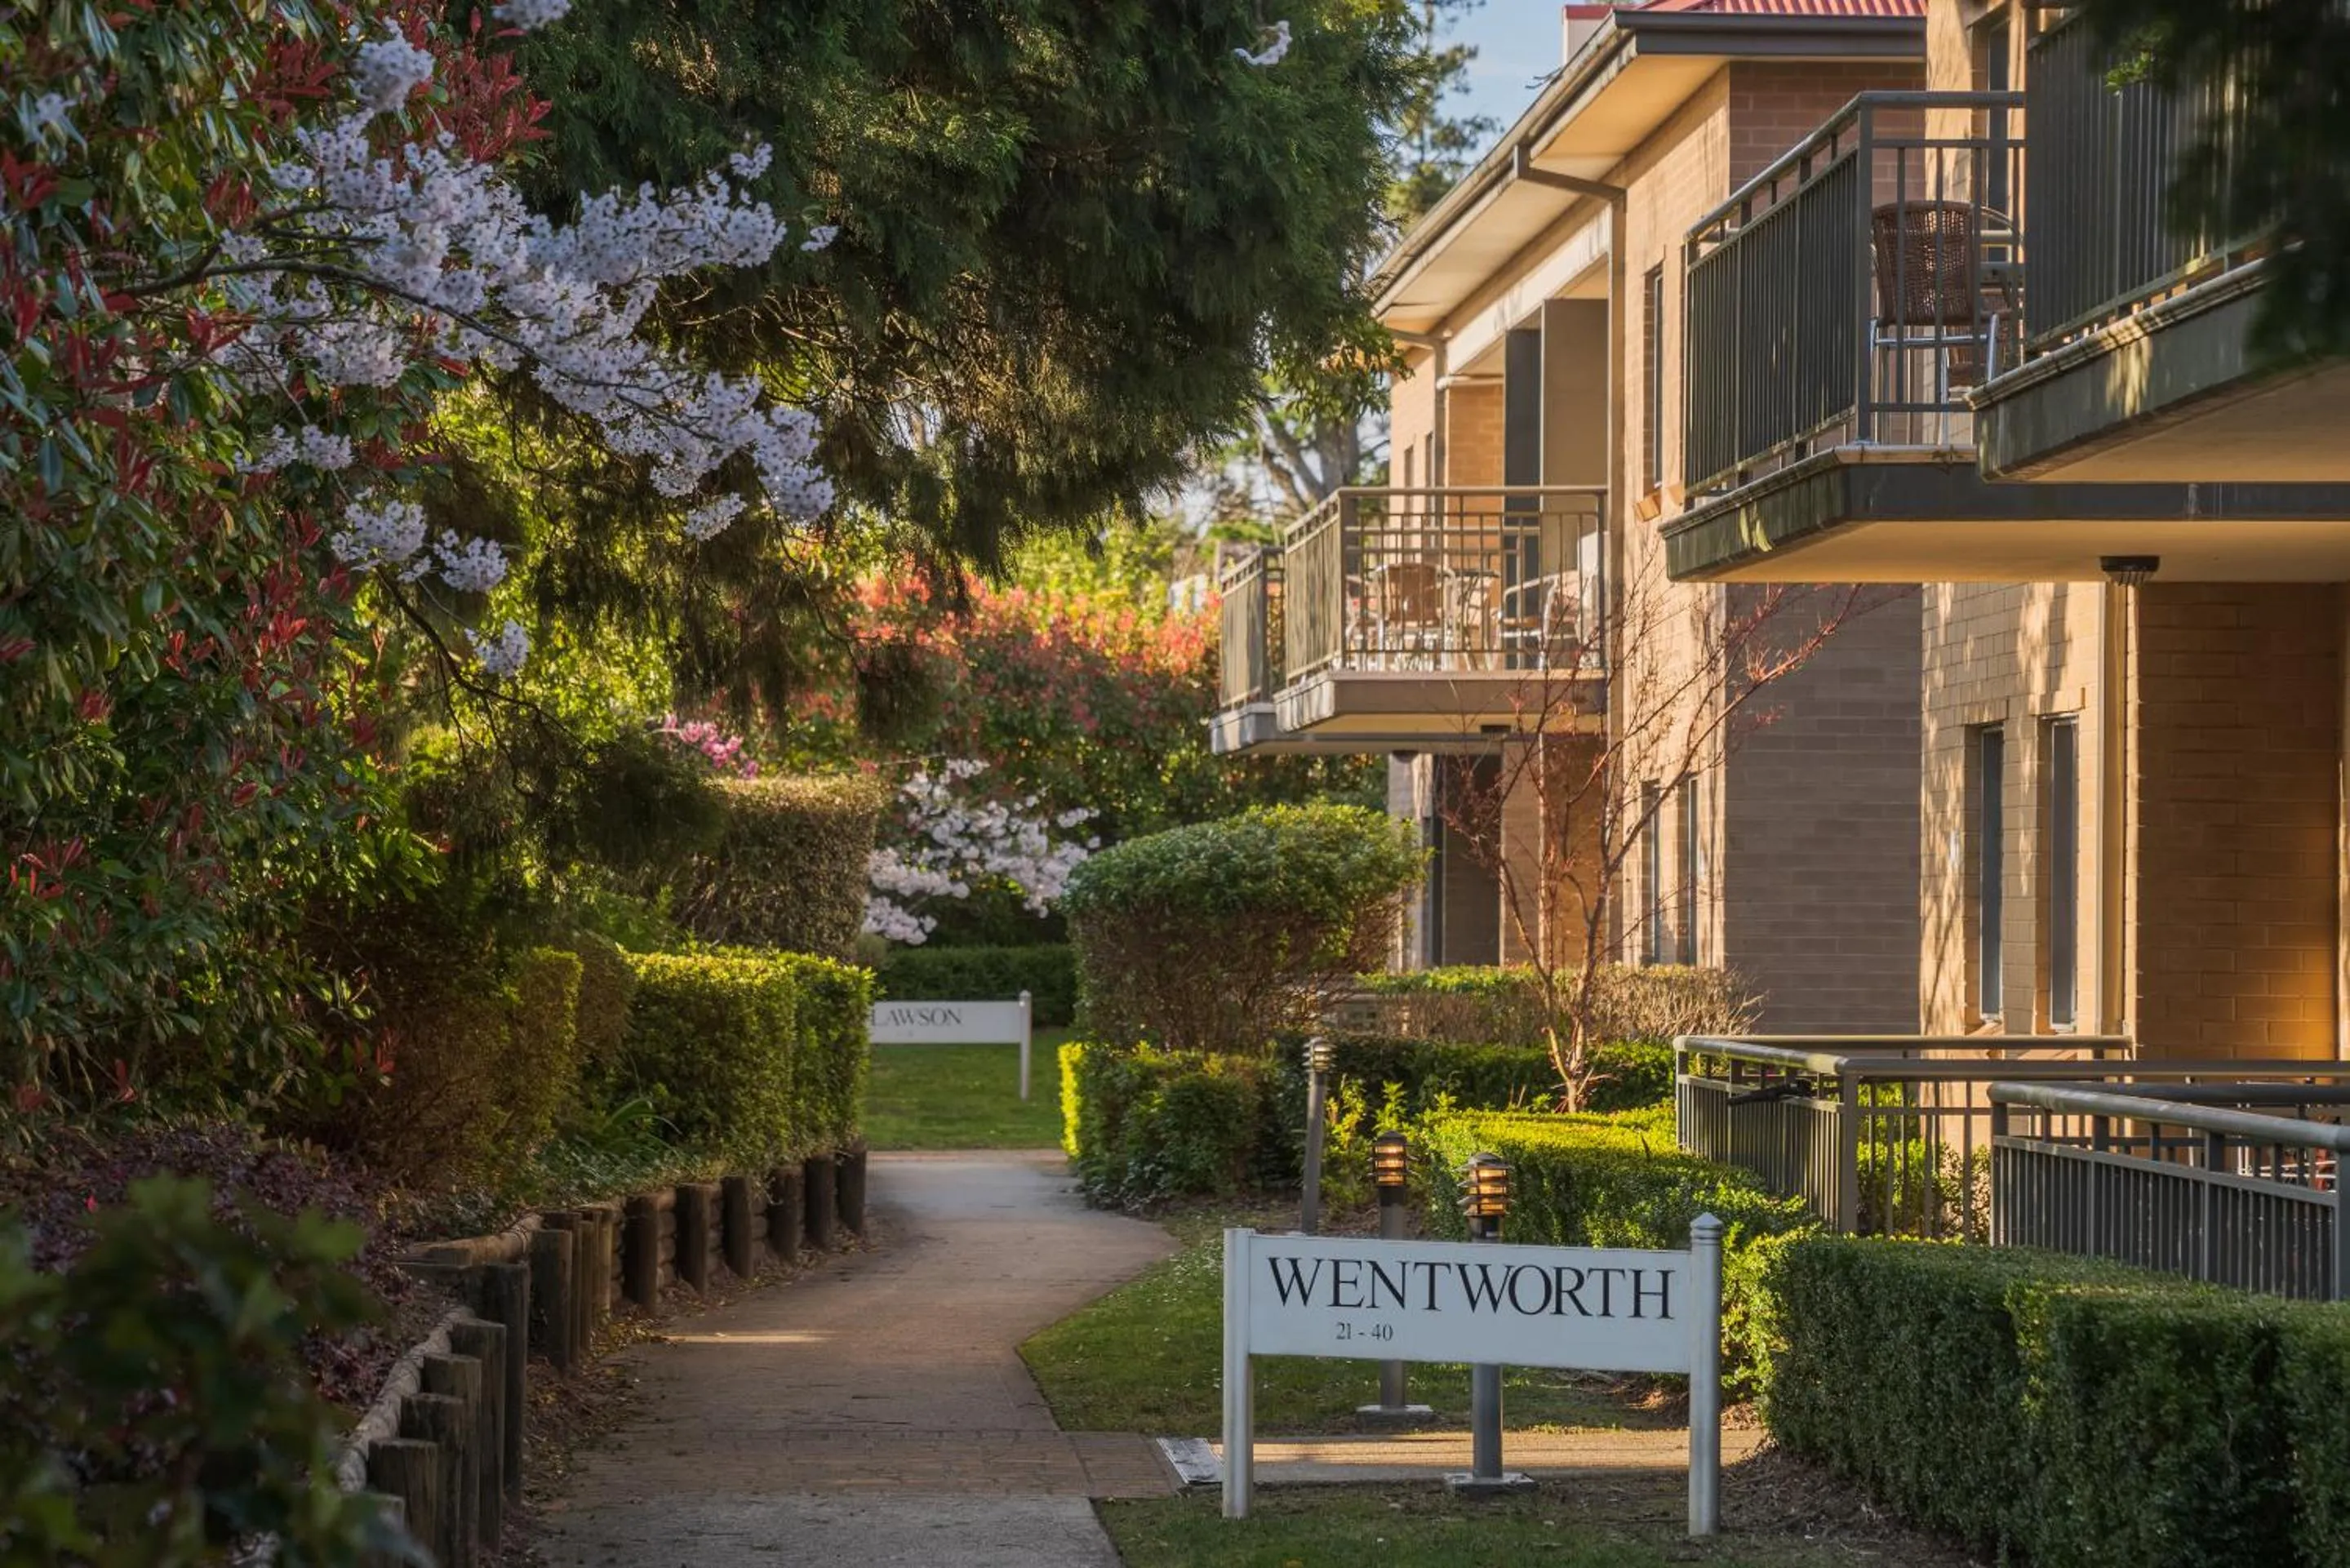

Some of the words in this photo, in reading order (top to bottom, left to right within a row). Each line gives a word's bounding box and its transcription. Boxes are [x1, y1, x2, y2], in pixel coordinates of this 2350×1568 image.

[1268, 1256, 1677, 1320] WENTWORTH
[1335, 1321, 1352, 1339] 21
[1371, 1323, 1393, 1342] 40
